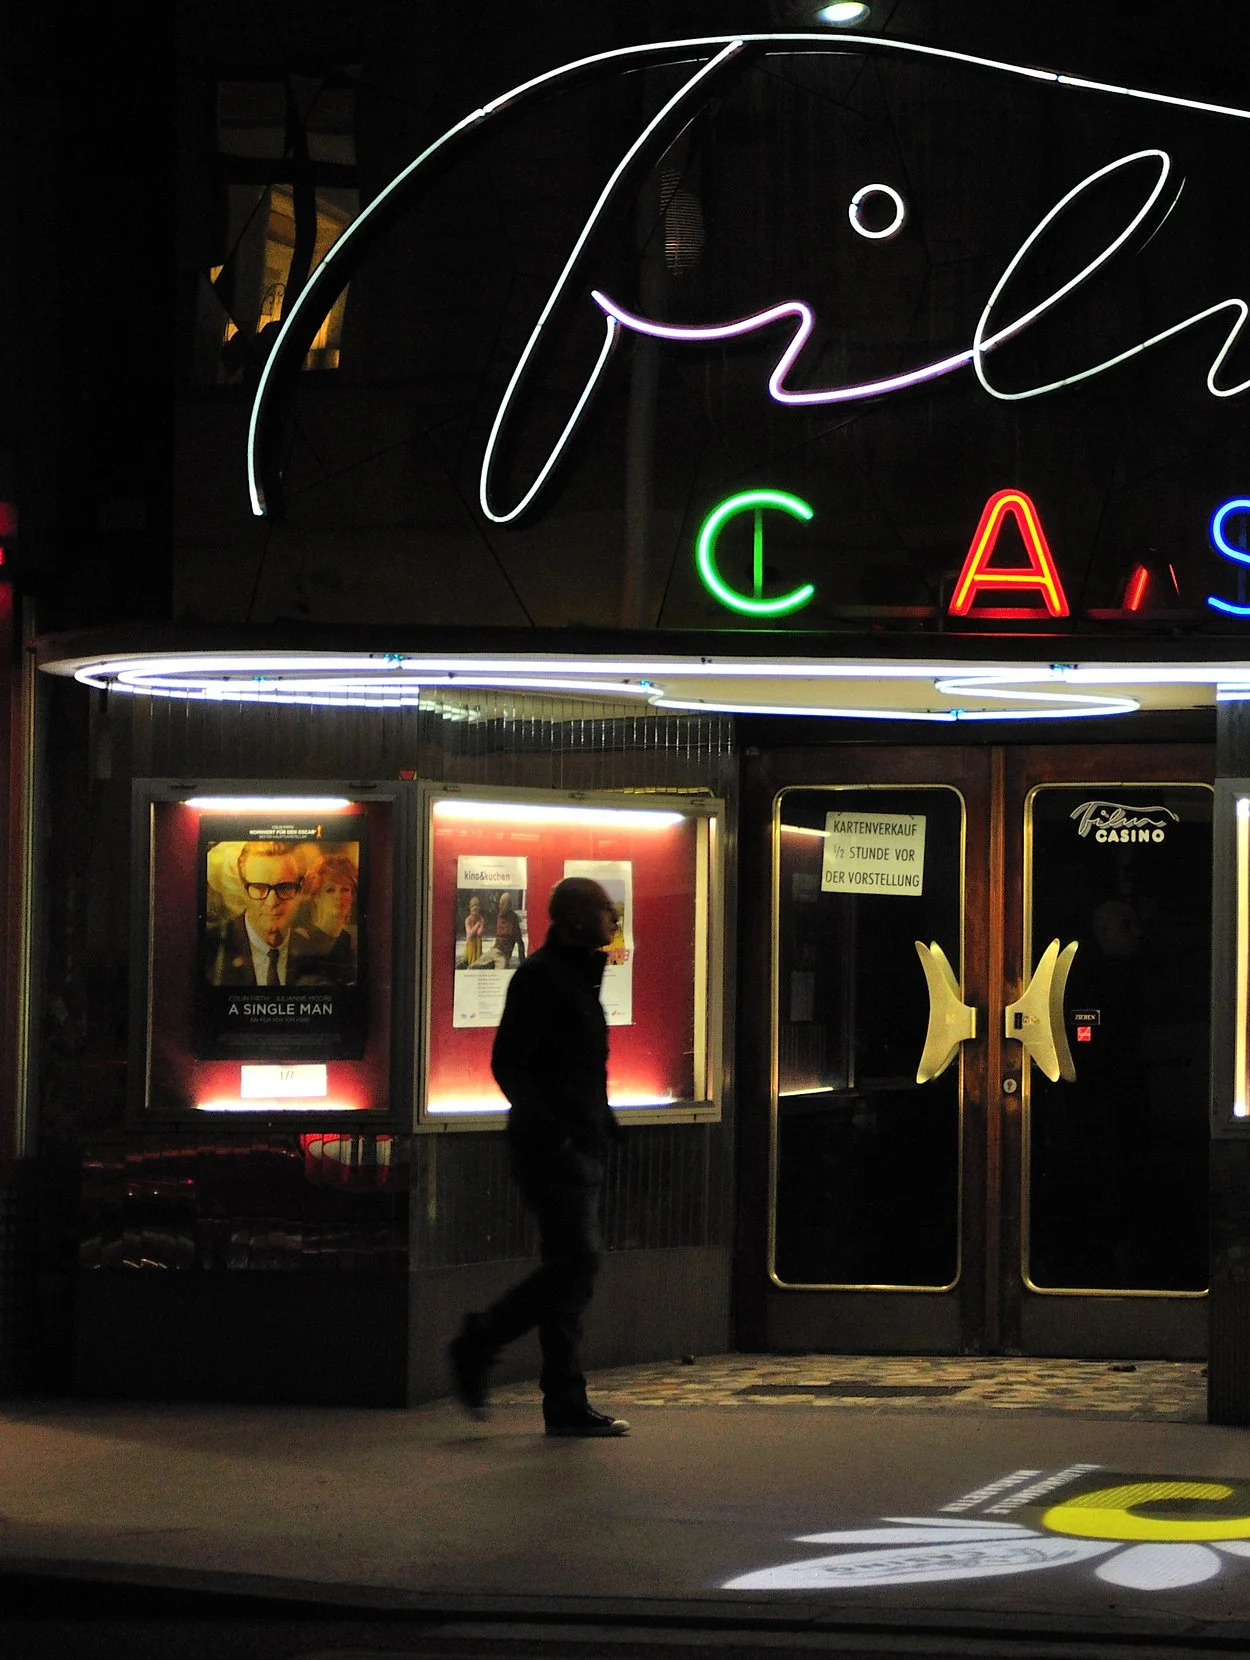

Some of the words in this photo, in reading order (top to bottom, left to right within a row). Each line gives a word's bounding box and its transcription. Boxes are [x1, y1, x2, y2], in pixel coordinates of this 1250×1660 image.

[1069, 800, 1180, 838] Film
[833, 820, 918, 837] KARTENVERKAUF
[1095, 829, 1165, 843] CASINO
[849, 846, 890, 861] STUNDE
[894, 848, 916, 862] VOR
[825, 870, 846, 884] DER
[848, 871, 921, 888] VORSTELLUNG
[228, 1003, 239, 1016] A
[243, 1003, 296, 1016] SINGLE
[300, 1003, 333, 1016] MAN
